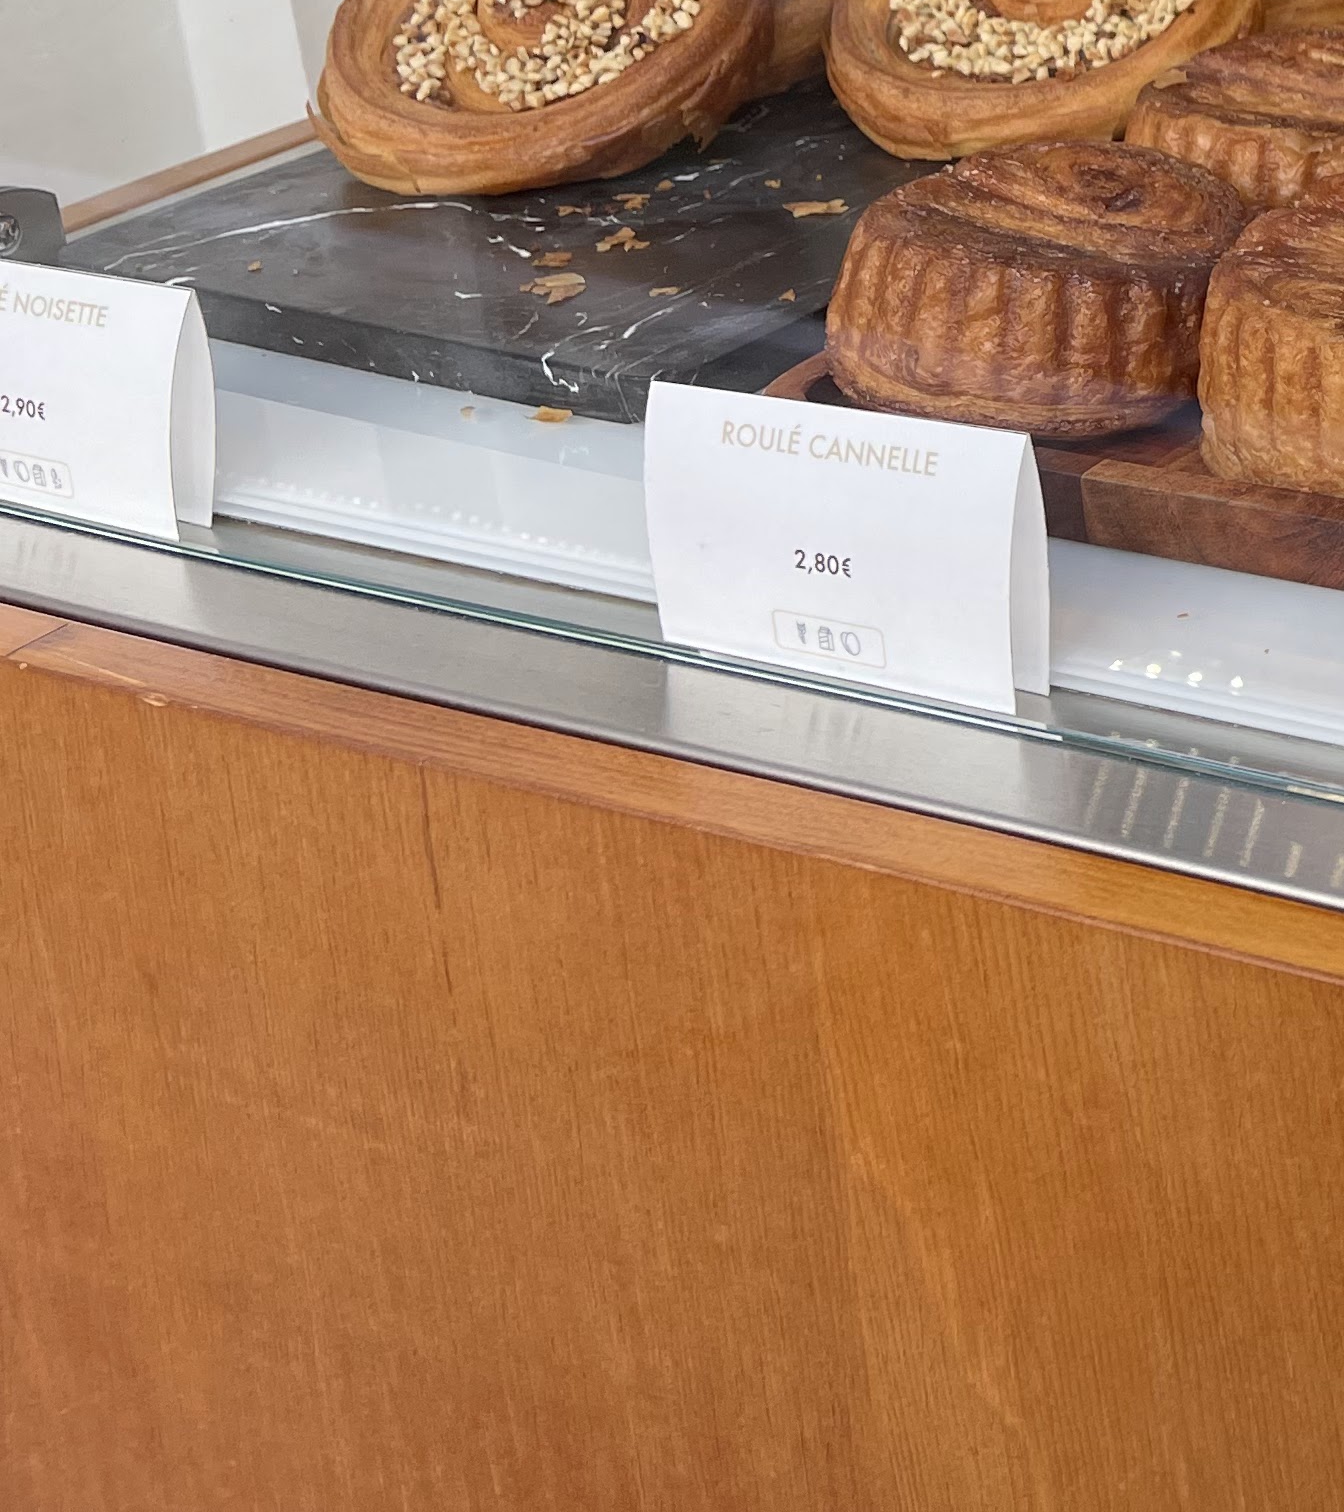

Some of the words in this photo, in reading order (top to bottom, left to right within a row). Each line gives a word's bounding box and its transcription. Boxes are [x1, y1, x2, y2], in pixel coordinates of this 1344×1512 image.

[12, 290, 109, 328] NOISETTE
[0, 394, 46, 421] 2,90€
[721, 420, 802, 456] ROULÉ
[808, 434, 939, 477] CANNELLE
[794, 549, 852, 579] 2,80€
